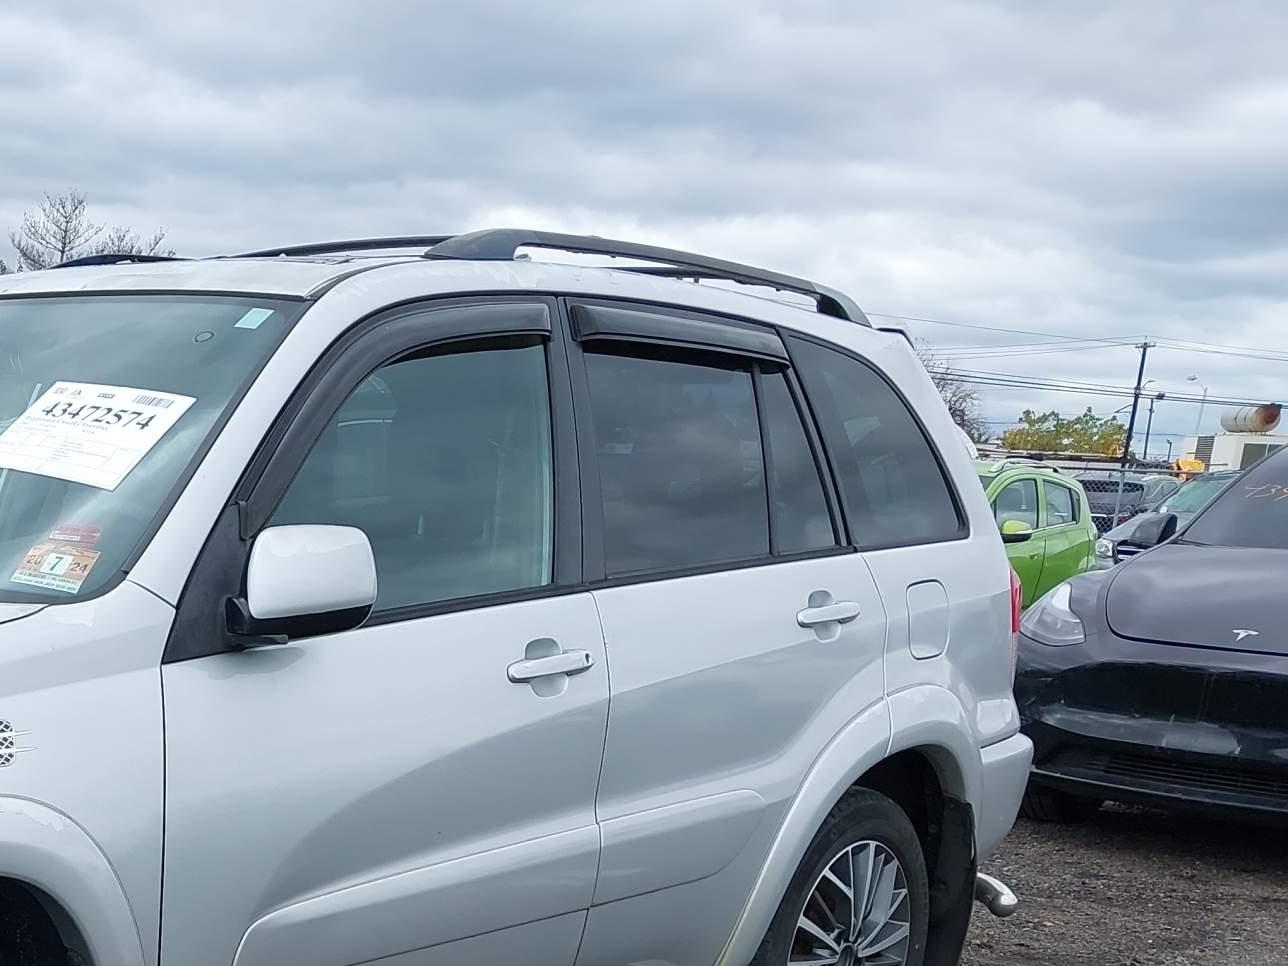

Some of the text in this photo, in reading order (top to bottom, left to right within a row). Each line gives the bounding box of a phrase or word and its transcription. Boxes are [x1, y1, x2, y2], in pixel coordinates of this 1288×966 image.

[41, 401, 157, 430] 43472574
[27, 554, 89, 574] 20 7 24
